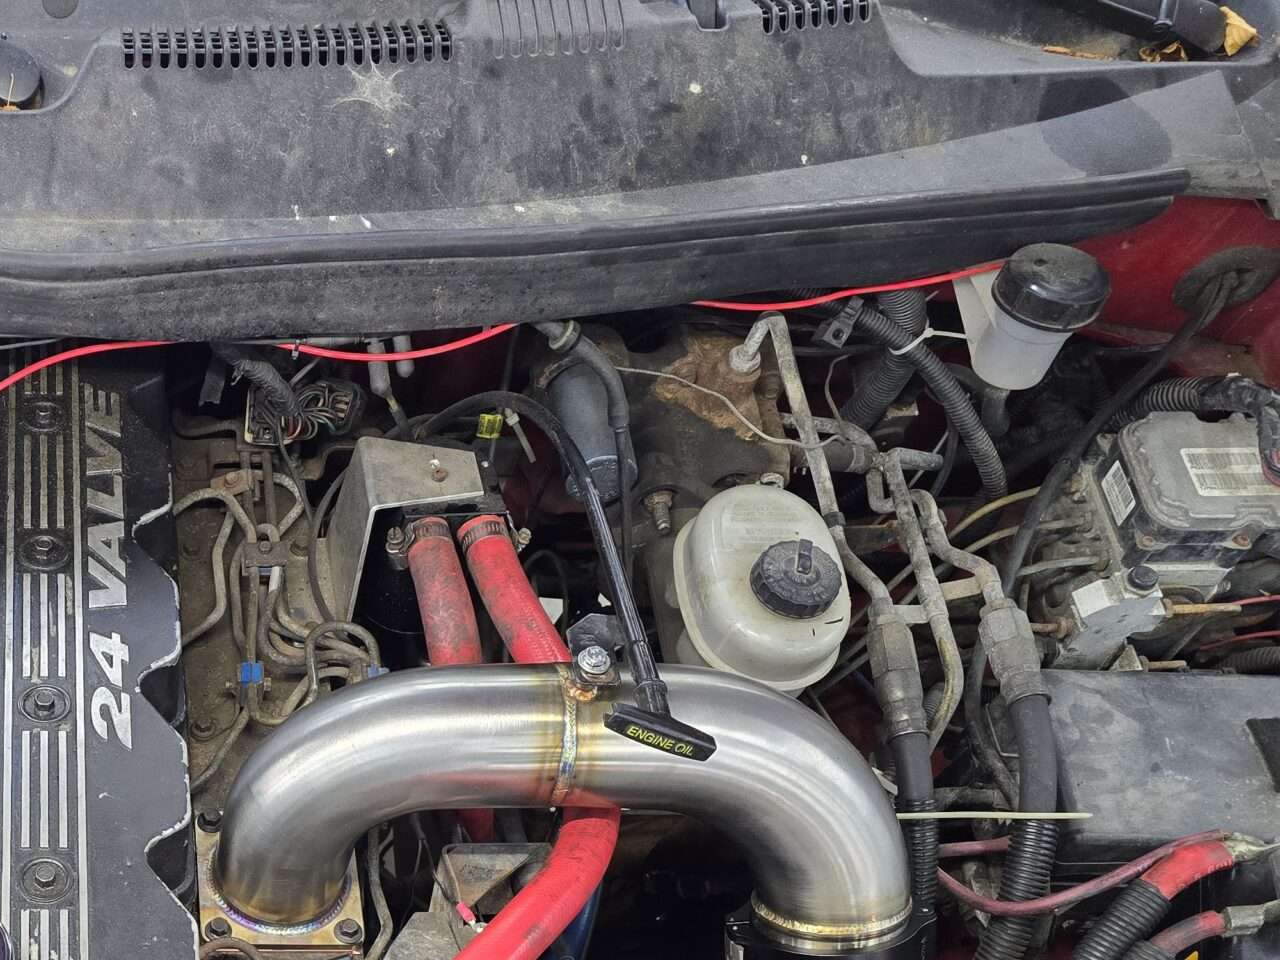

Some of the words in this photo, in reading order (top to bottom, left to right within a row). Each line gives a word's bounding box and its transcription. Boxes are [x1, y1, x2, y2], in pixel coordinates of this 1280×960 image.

[82, 380, 129, 609] VALVE
[90, 631, 133, 750] 24
[626, 725, 675, 750] ENGINE
[674, 743, 694, 757] OIL
